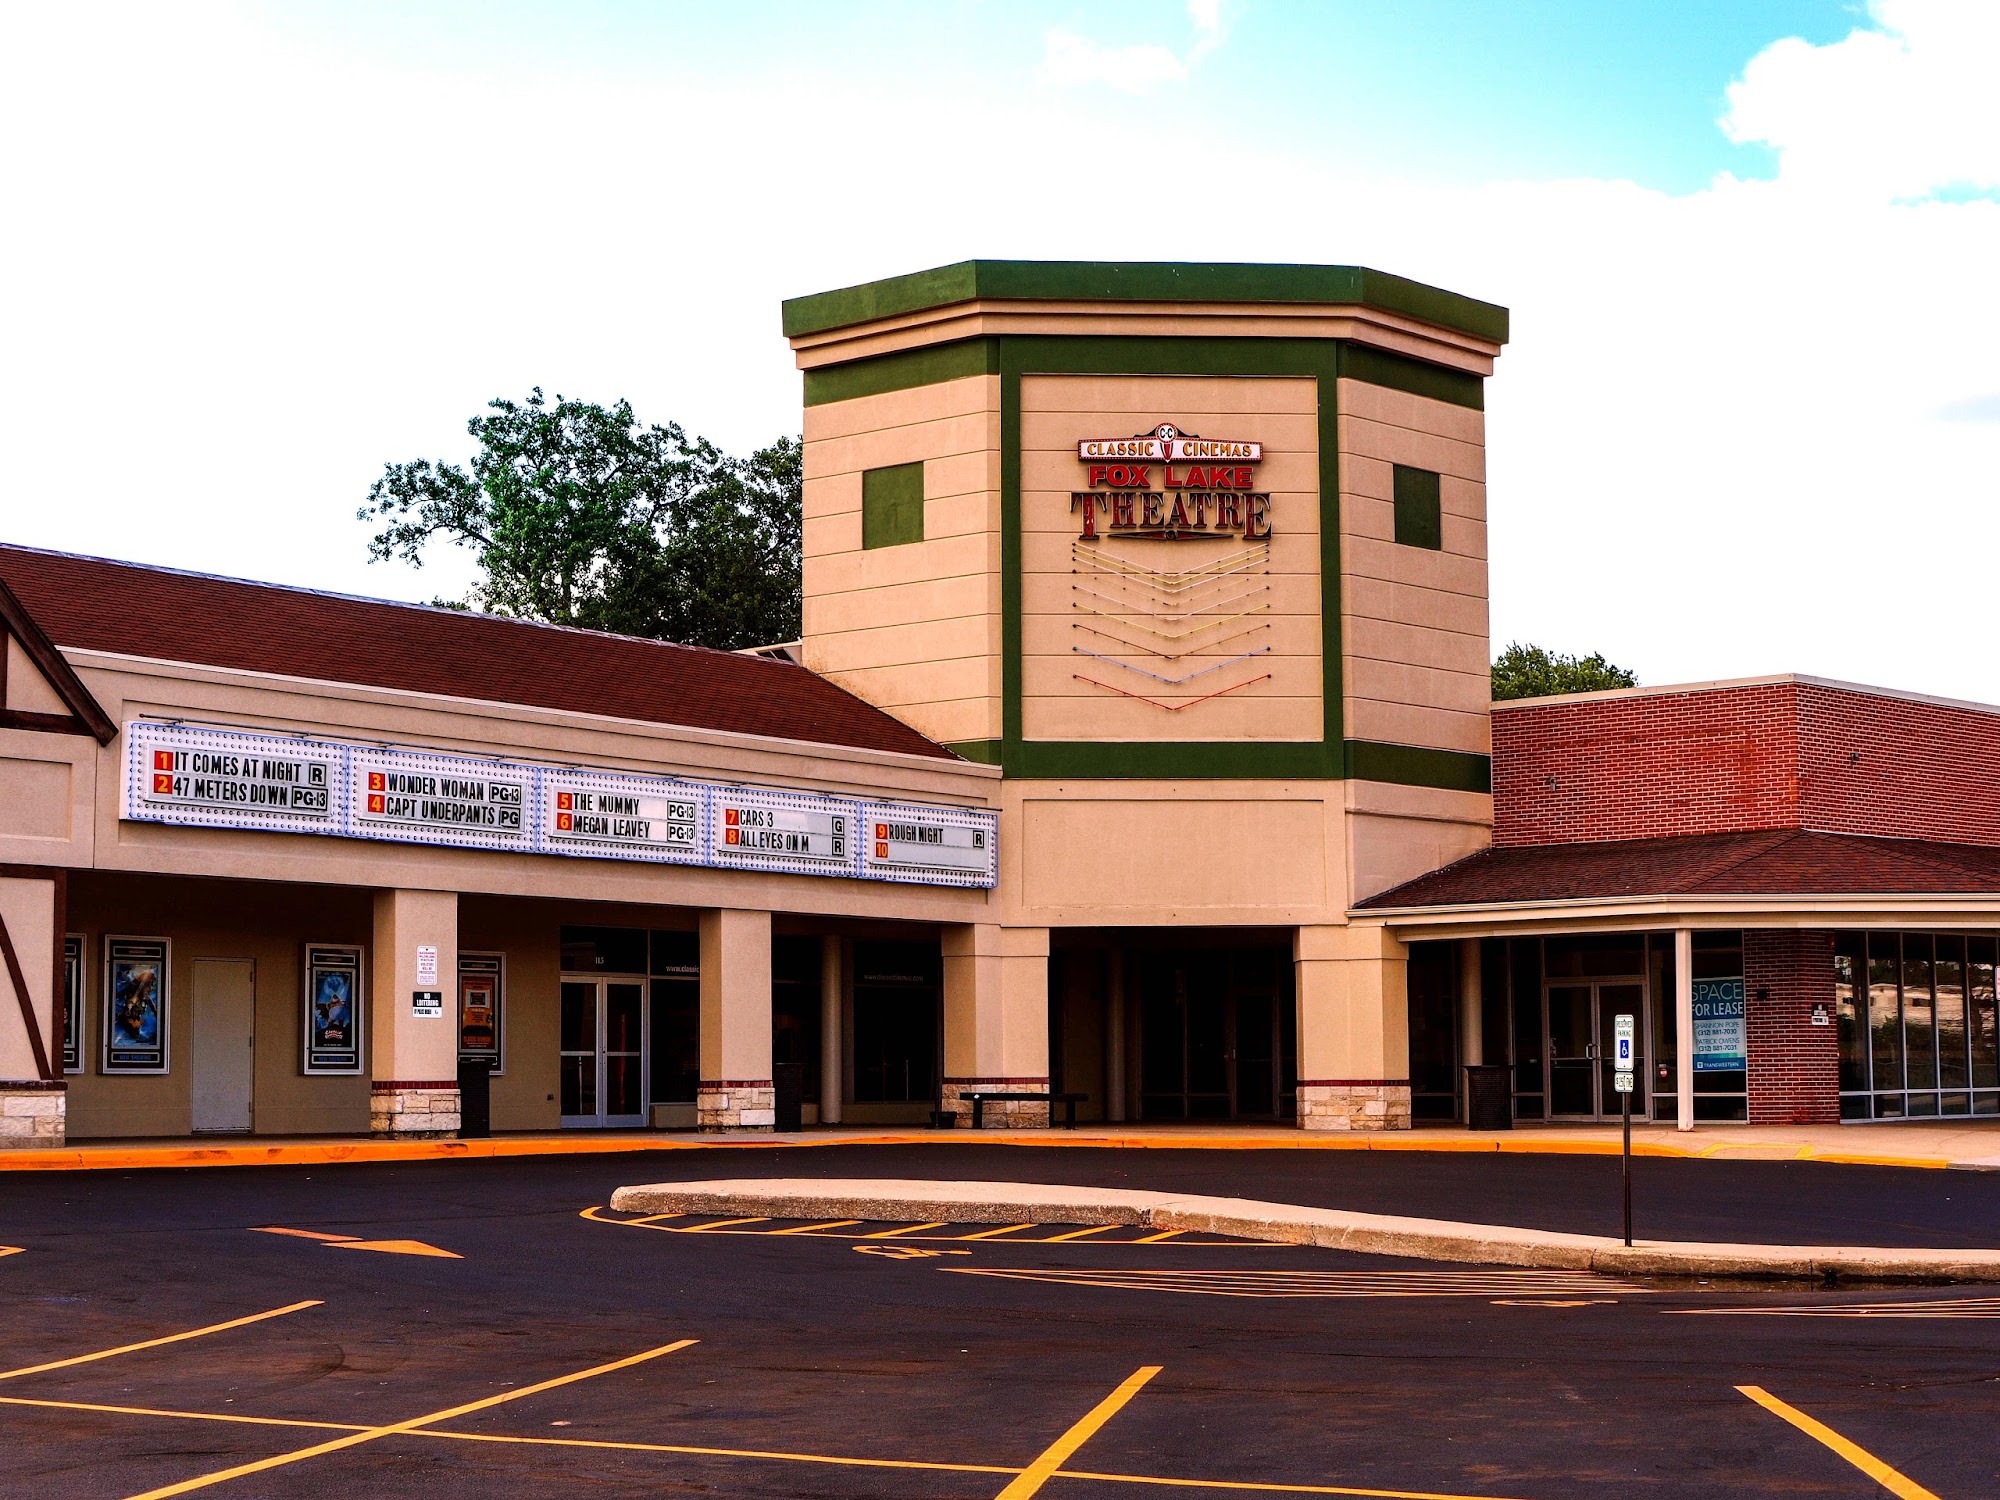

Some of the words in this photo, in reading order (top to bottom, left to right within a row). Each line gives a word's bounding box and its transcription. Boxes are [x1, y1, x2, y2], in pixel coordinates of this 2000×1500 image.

[1087, 441, 1154, 456] CLASSIC
[1182, 442, 1253, 457] CINEMAS
[1088, 465, 1151, 488] FOX
[1164, 466, 1254, 489] LAKE
[1070, 492, 1273, 540] THEATRE
[159, 753, 168, 769] 1
[174, 751, 189, 771] IT
[192, 753, 239, 776] COMES
[242, 758, 259, 778] AT
[262, 760, 302, 783] NIGHT
[312, 767, 323, 783] R
[157, 776, 169, 793] 2
[173, 777, 190, 797] 47
[194, 779, 248, 802] METERS
[250, 784, 288, 806] DOWN
[371, 774, 382, 790] 3
[387, 773, 437, 796] WONDER
[440, 778, 485, 801] WOMAN
[371, 796, 382, 811] 4
[387, 797, 417, 817] CAPT
[421, 800, 495, 825] UNDERPANTS
[501, 811, 519, 825] PG
[560, 794, 569, 808] 5
[573, 793, 593, 811] THE
[598, 795, 640, 815] MUMMY
[560, 815, 569, 829] 6
[573, 815, 608, 835] MEGAN
[613, 818, 650, 838] LEAVEY
[740, 809, 764, 827] CARS
[767, 811, 774, 828] 3
[740, 830, 757, 848] ALL
[760, 831, 783, 849] EYES
[786, 834, 798, 851] ON
[801, 835, 809, 852] M
[889, 824, 917, 841] ROUGH
[919, 826, 944, 844] NIGHT
[877, 843, 888, 857] 10
[1692, 983, 1743, 1001] SPACE
[1713, 1002, 1743, 1015] LEASE
